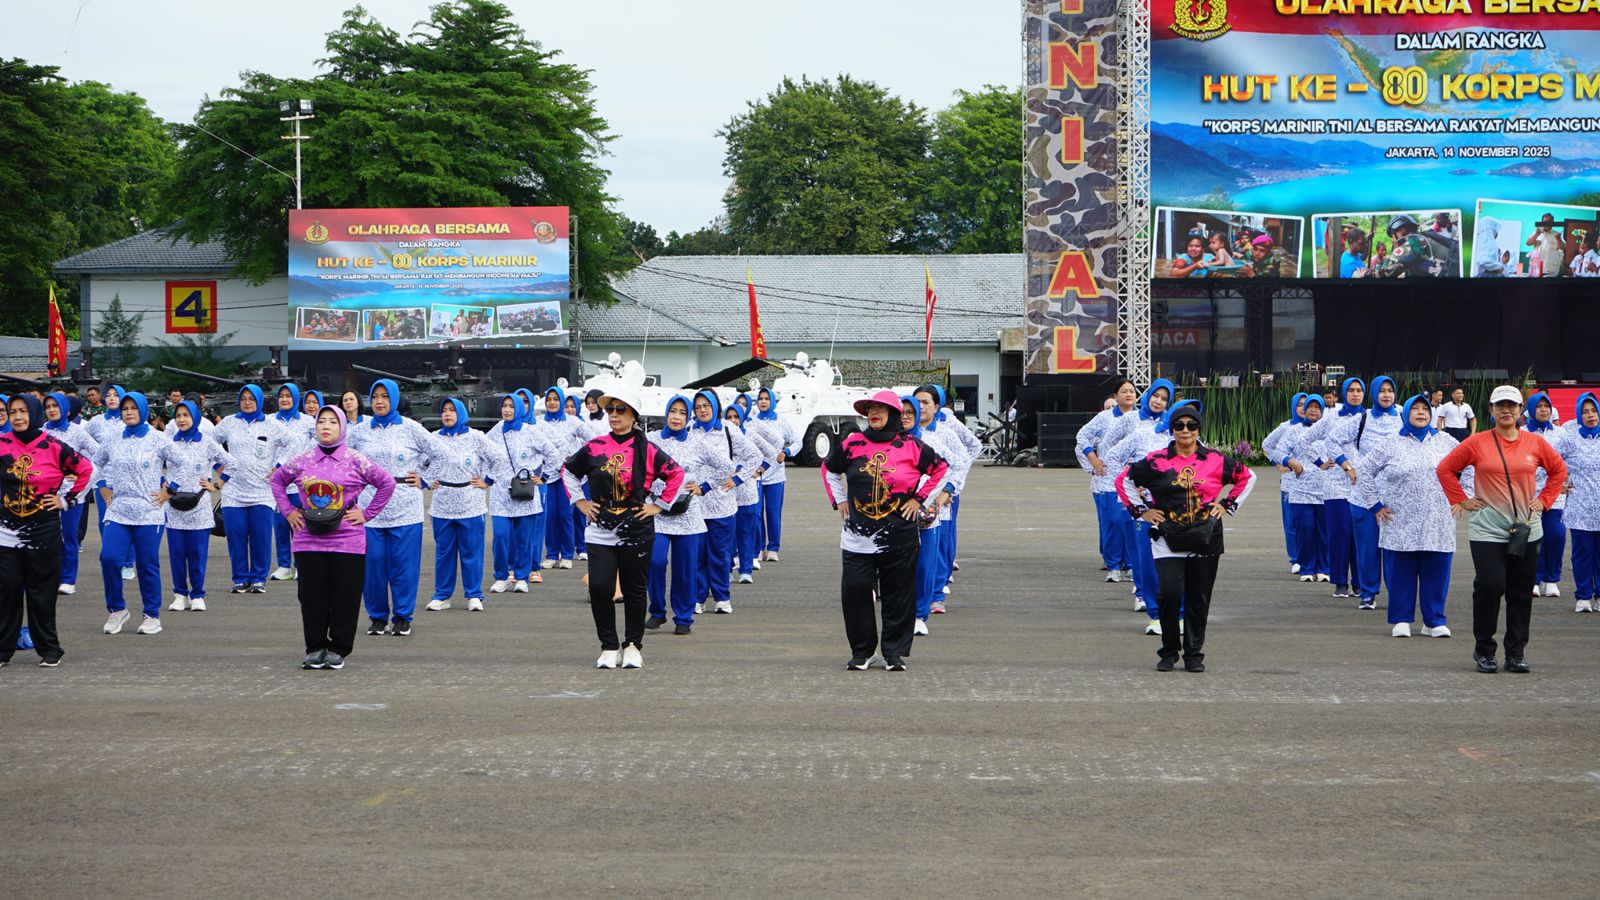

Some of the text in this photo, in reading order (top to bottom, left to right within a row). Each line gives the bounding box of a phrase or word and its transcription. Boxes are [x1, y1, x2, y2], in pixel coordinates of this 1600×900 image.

[1396, 32, 1545, 49] DALAM RANGKA
[1203, 75, 1278, 101] HUT
[1290, 75, 1336, 101] KE
[1382, 66, 1428, 105] 80
[1442, 74, 1564, 100] KORPS
[1204, 120, 1260, 133] "KORPS
[1264, 120, 1326, 133] MARINIR
[1329, 120, 1351, 132] TNI
[1355, 120, 1373, 132] AL
[1376, 120, 1445, 132] BERSAMA
[1449, 119, 1502, 132] RAKYAT
[1386, 147, 1551, 158] JAKARTA, 14 NOVEMBER 2025
[348, 223, 511, 235] OLAHRAGA BERSAMA
[428, 240, 461, 248] RANGKA
[317, 256, 348, 267] HUT
[354, 257, 374, 267] KE
[417, 256, 468, 267] KORPS
[473, 255, 537, 266] MARINIR
[175, 290, 208, 324] 4
